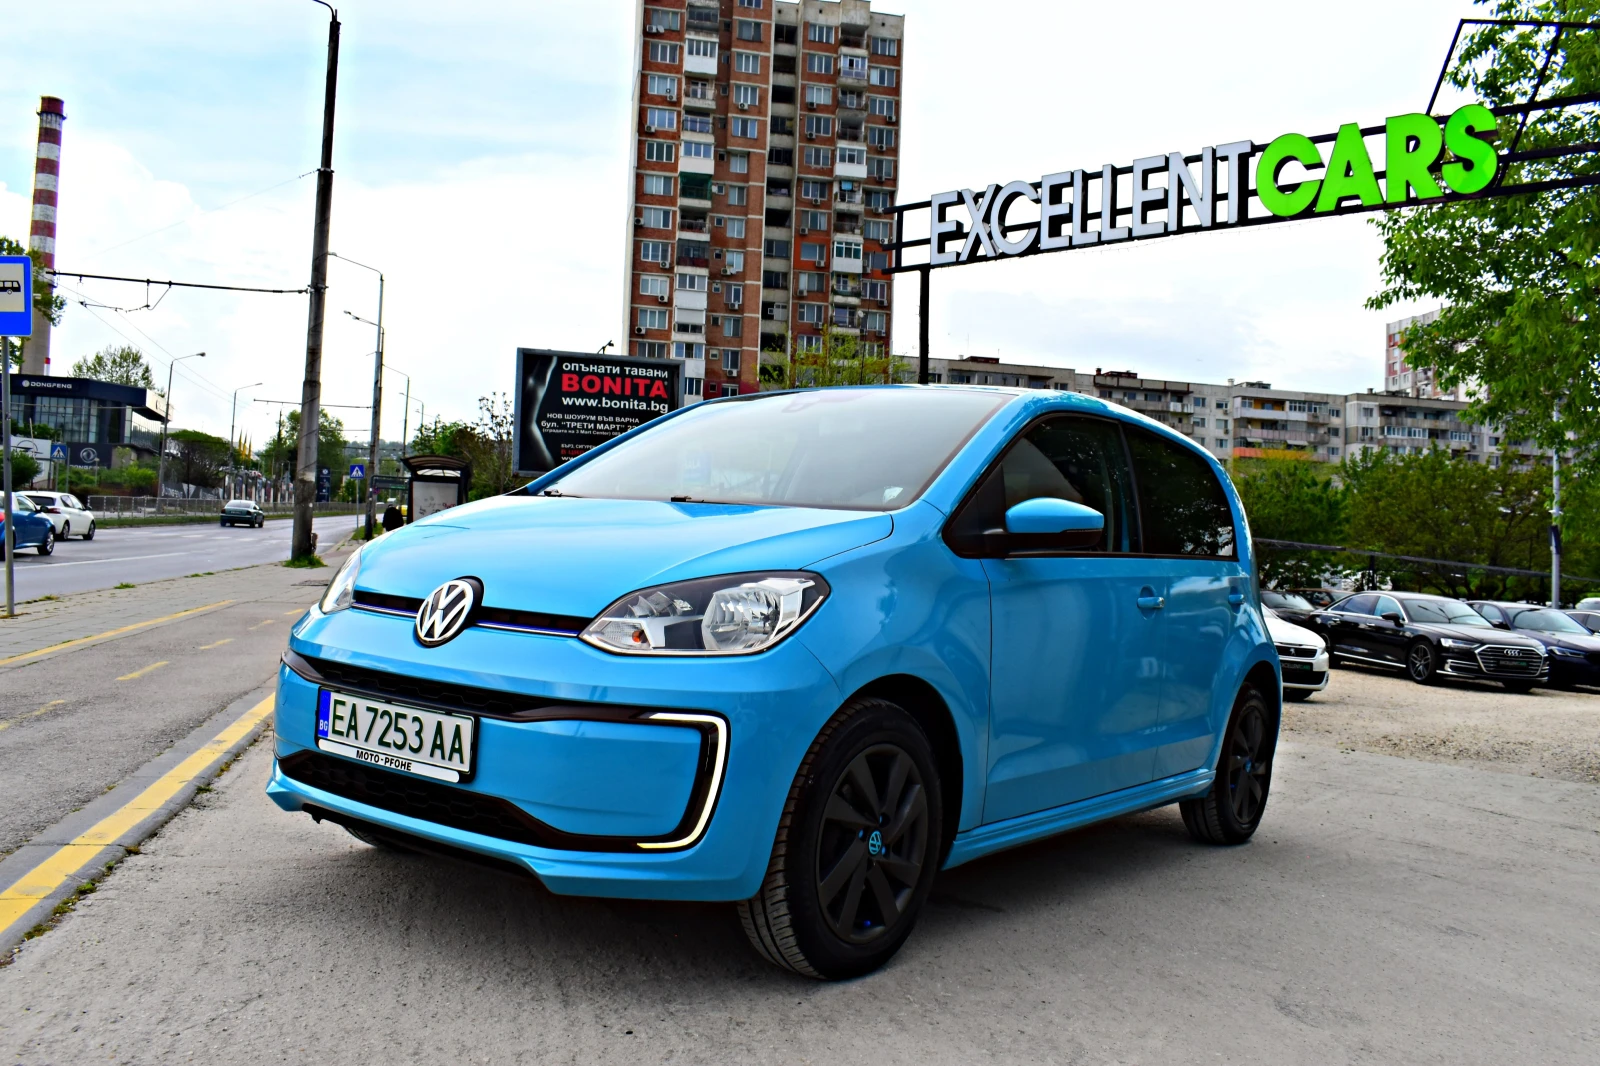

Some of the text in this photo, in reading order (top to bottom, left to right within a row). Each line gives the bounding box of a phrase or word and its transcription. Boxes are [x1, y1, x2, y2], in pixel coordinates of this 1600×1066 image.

[929, 104, 1498, 265] EXCELLENT CARS
[562, 362, 668, 378] опънати тавани
[30, 381, 73, 389] DONGFENG
[561, 373, 668, 398] BONITA
[562, 396, 669, 414] www.bonita.bg
[541, 420, 559, 428] бул.
[564, 413, 596, 421] ШОУРУМ
[615, 416, 640, 424] ВАРНА
[319, 719, 328, 731] BG
[331, 698, 465, 765] EA 7253 AA
[355, 749, 413, 772] MOTO-PFOHE
